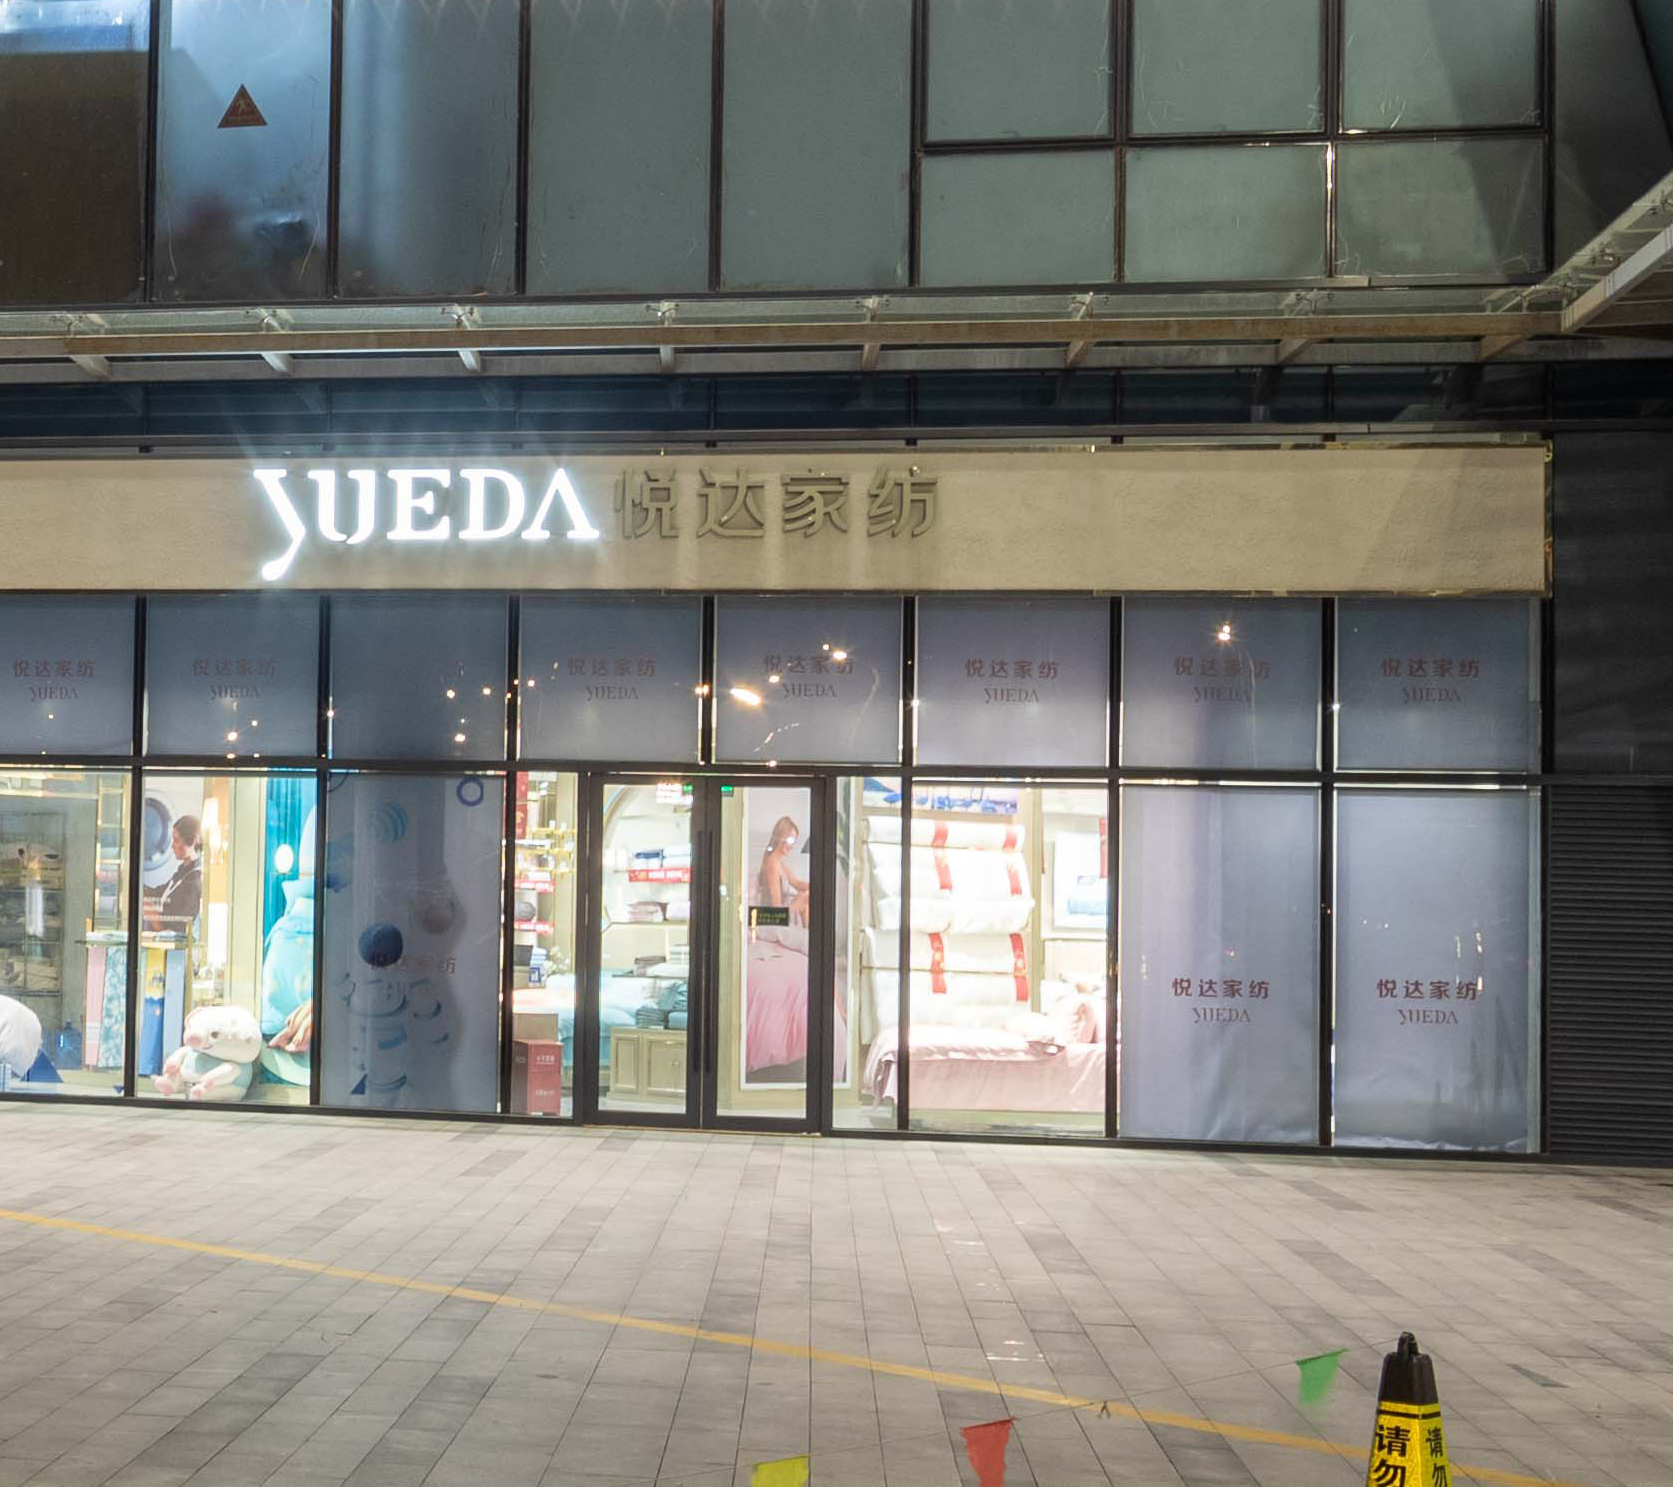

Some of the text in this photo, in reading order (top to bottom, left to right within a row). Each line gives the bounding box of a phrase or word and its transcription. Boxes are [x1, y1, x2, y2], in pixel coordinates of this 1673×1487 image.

[613, 467, 938, 540] 悦达家纺
[13, 659, 96, 678] 悦达家纺
[191, 658, 277, 677] 悦达家纺
[566, 658, 656, 677] 悦达家纺
[762, 654, 855, 675] 悦达家纺
[964, 659, 1060, 679] 悦达家纺
[1174, 657, 1271, 680] 悦达家纺
[1381, 658, 1481, 679] 悦达家纺
[1172, 977, 1270, 1000] 悦达家纺
[1376, 979, 1479, 1001] 悦达家纺
[1375, 1425, 1411, 1487] 请勿
